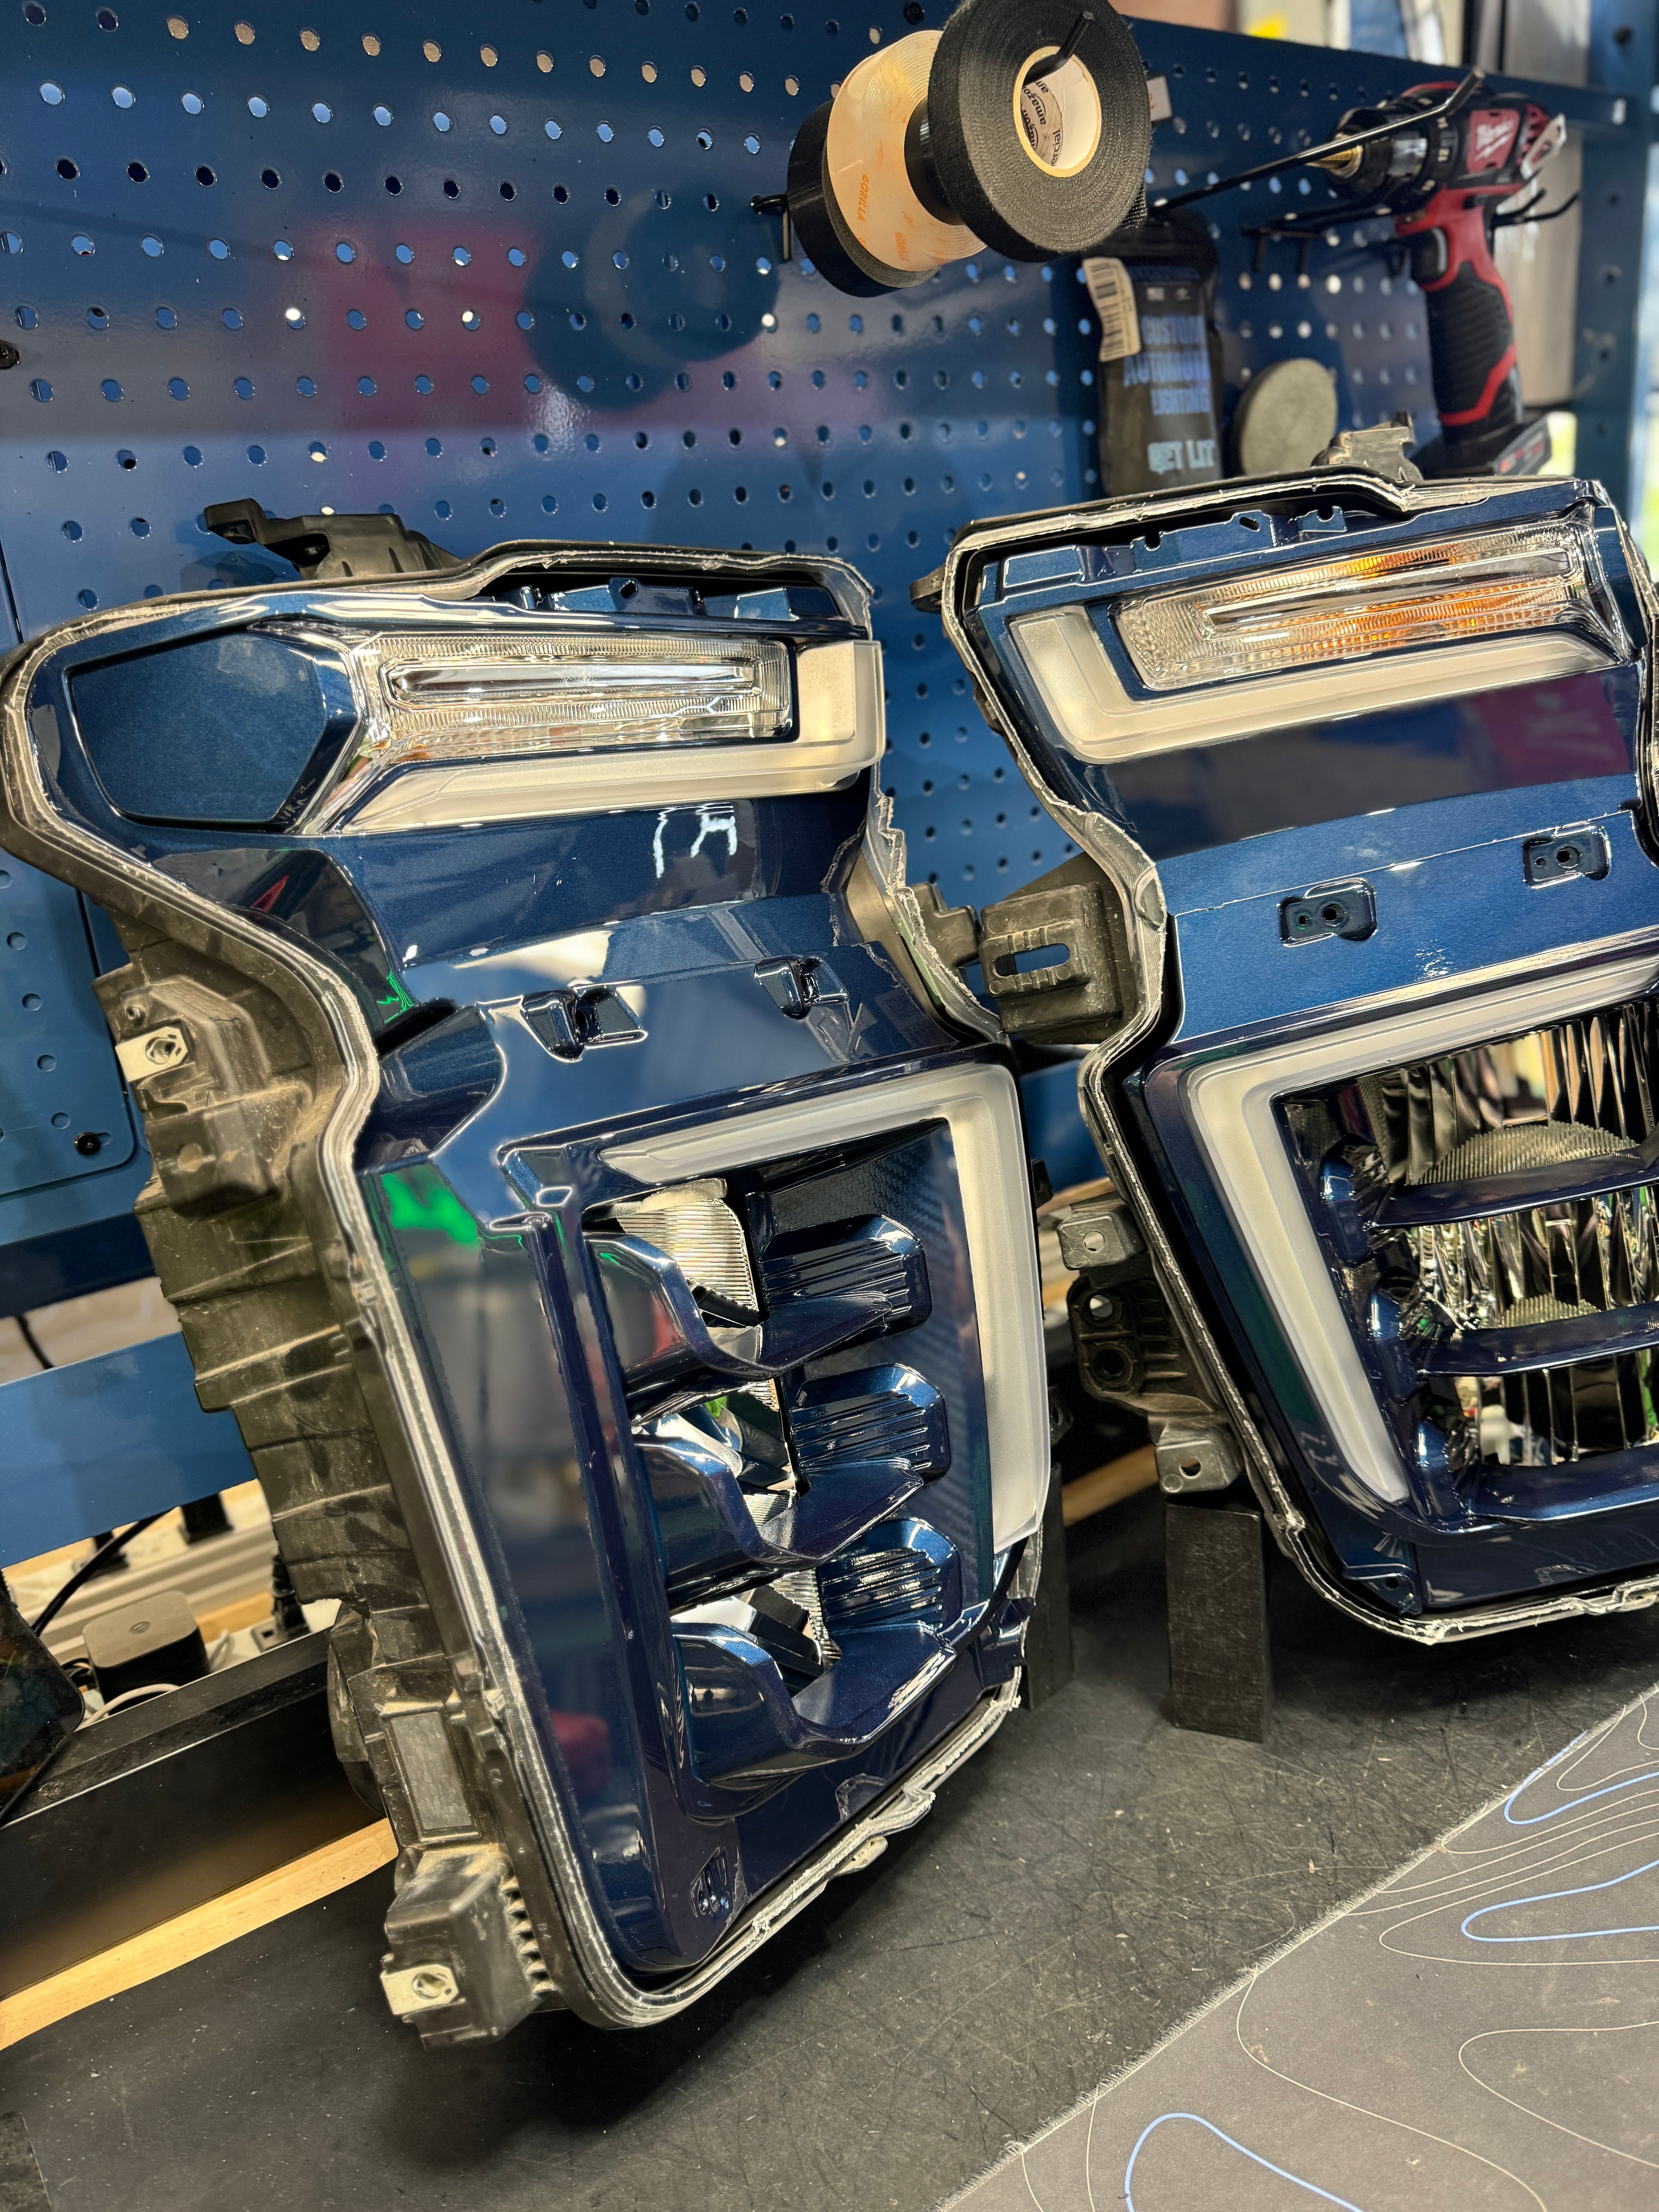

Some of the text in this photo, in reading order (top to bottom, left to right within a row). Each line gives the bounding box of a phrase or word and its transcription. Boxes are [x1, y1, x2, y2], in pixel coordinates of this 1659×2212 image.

[1051, 129, 1061, 166] ercial
[858, 174, 869, 222] GORILLA
[1186, 439, 1215, 469] LIT
